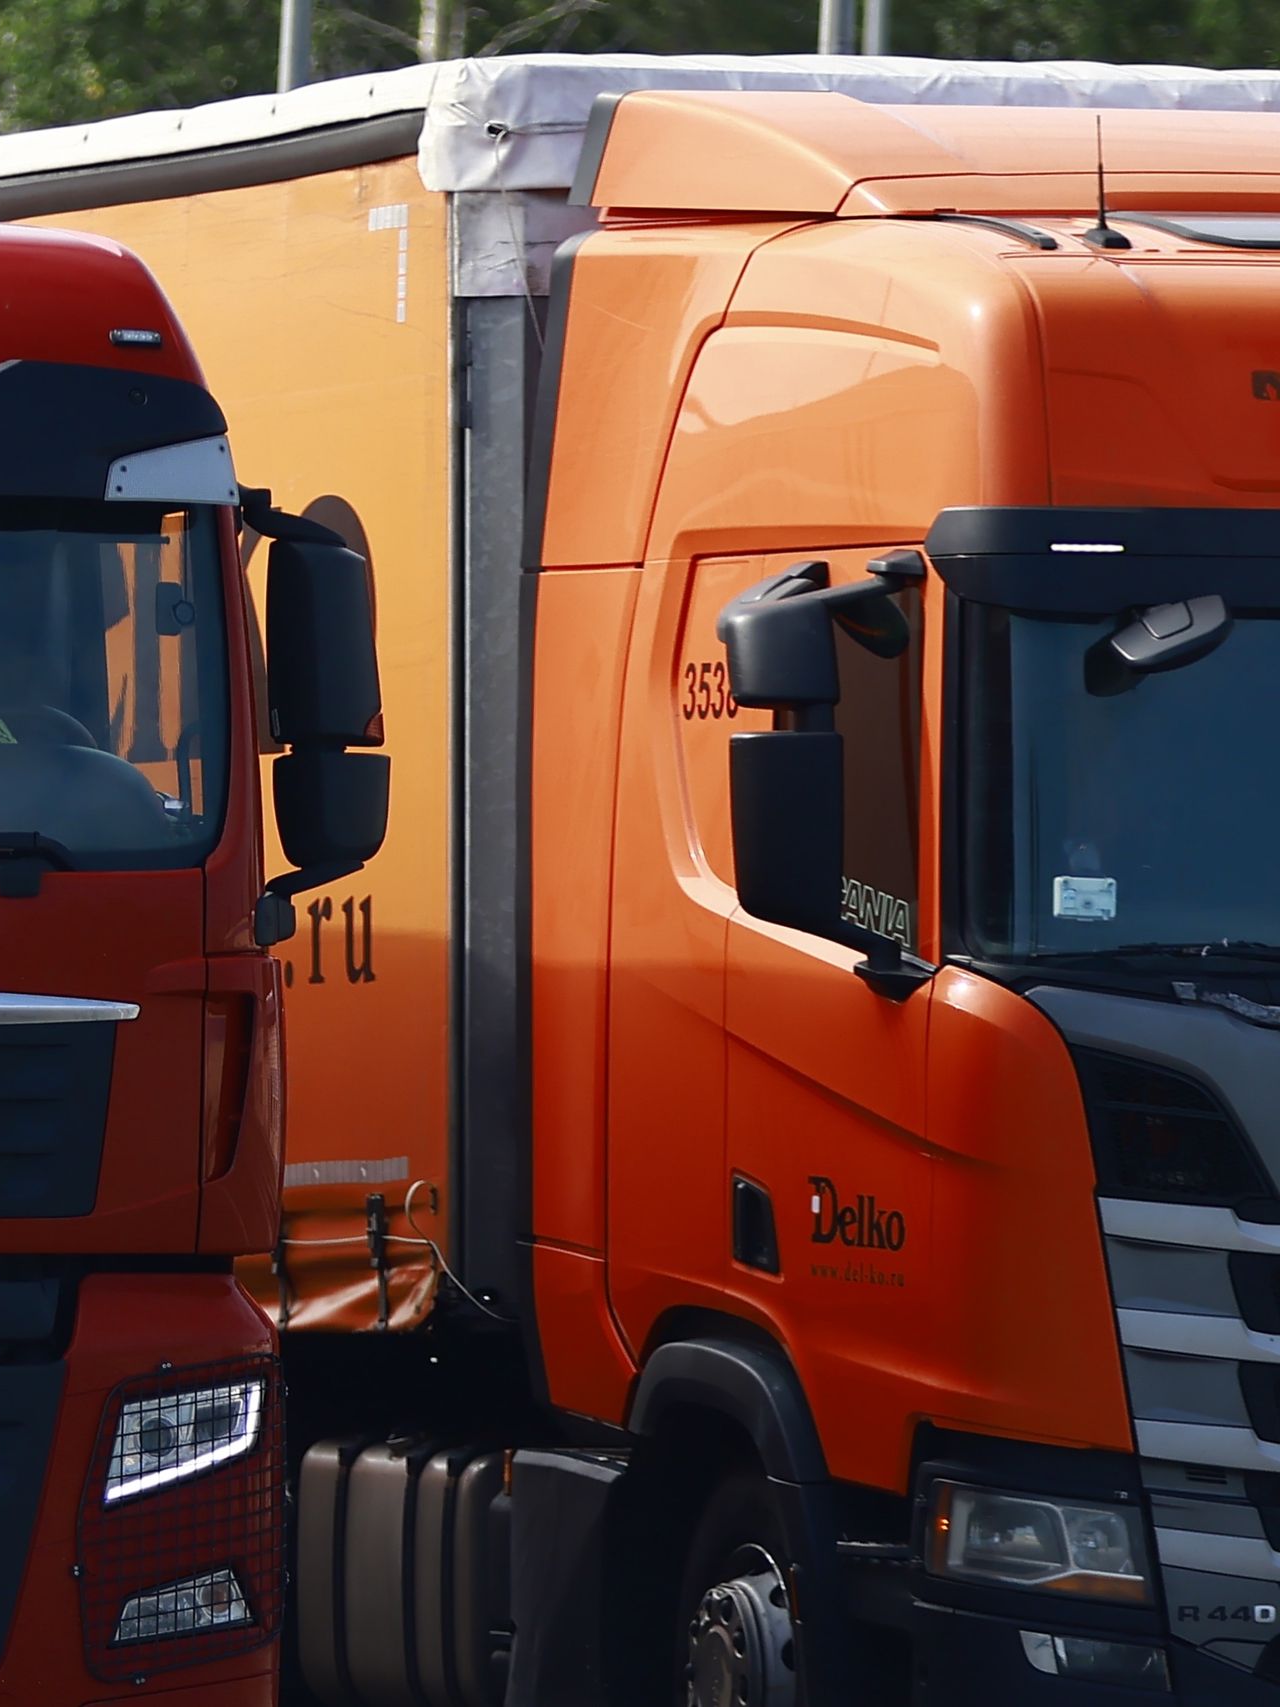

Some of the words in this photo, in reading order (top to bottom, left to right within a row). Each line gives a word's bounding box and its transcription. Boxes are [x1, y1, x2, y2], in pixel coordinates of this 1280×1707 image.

[807, 1175, 906, 1252] Delko
[1178, 1605, 1200, 1622] R
[1207, 1604, 1276, 1624] 440
